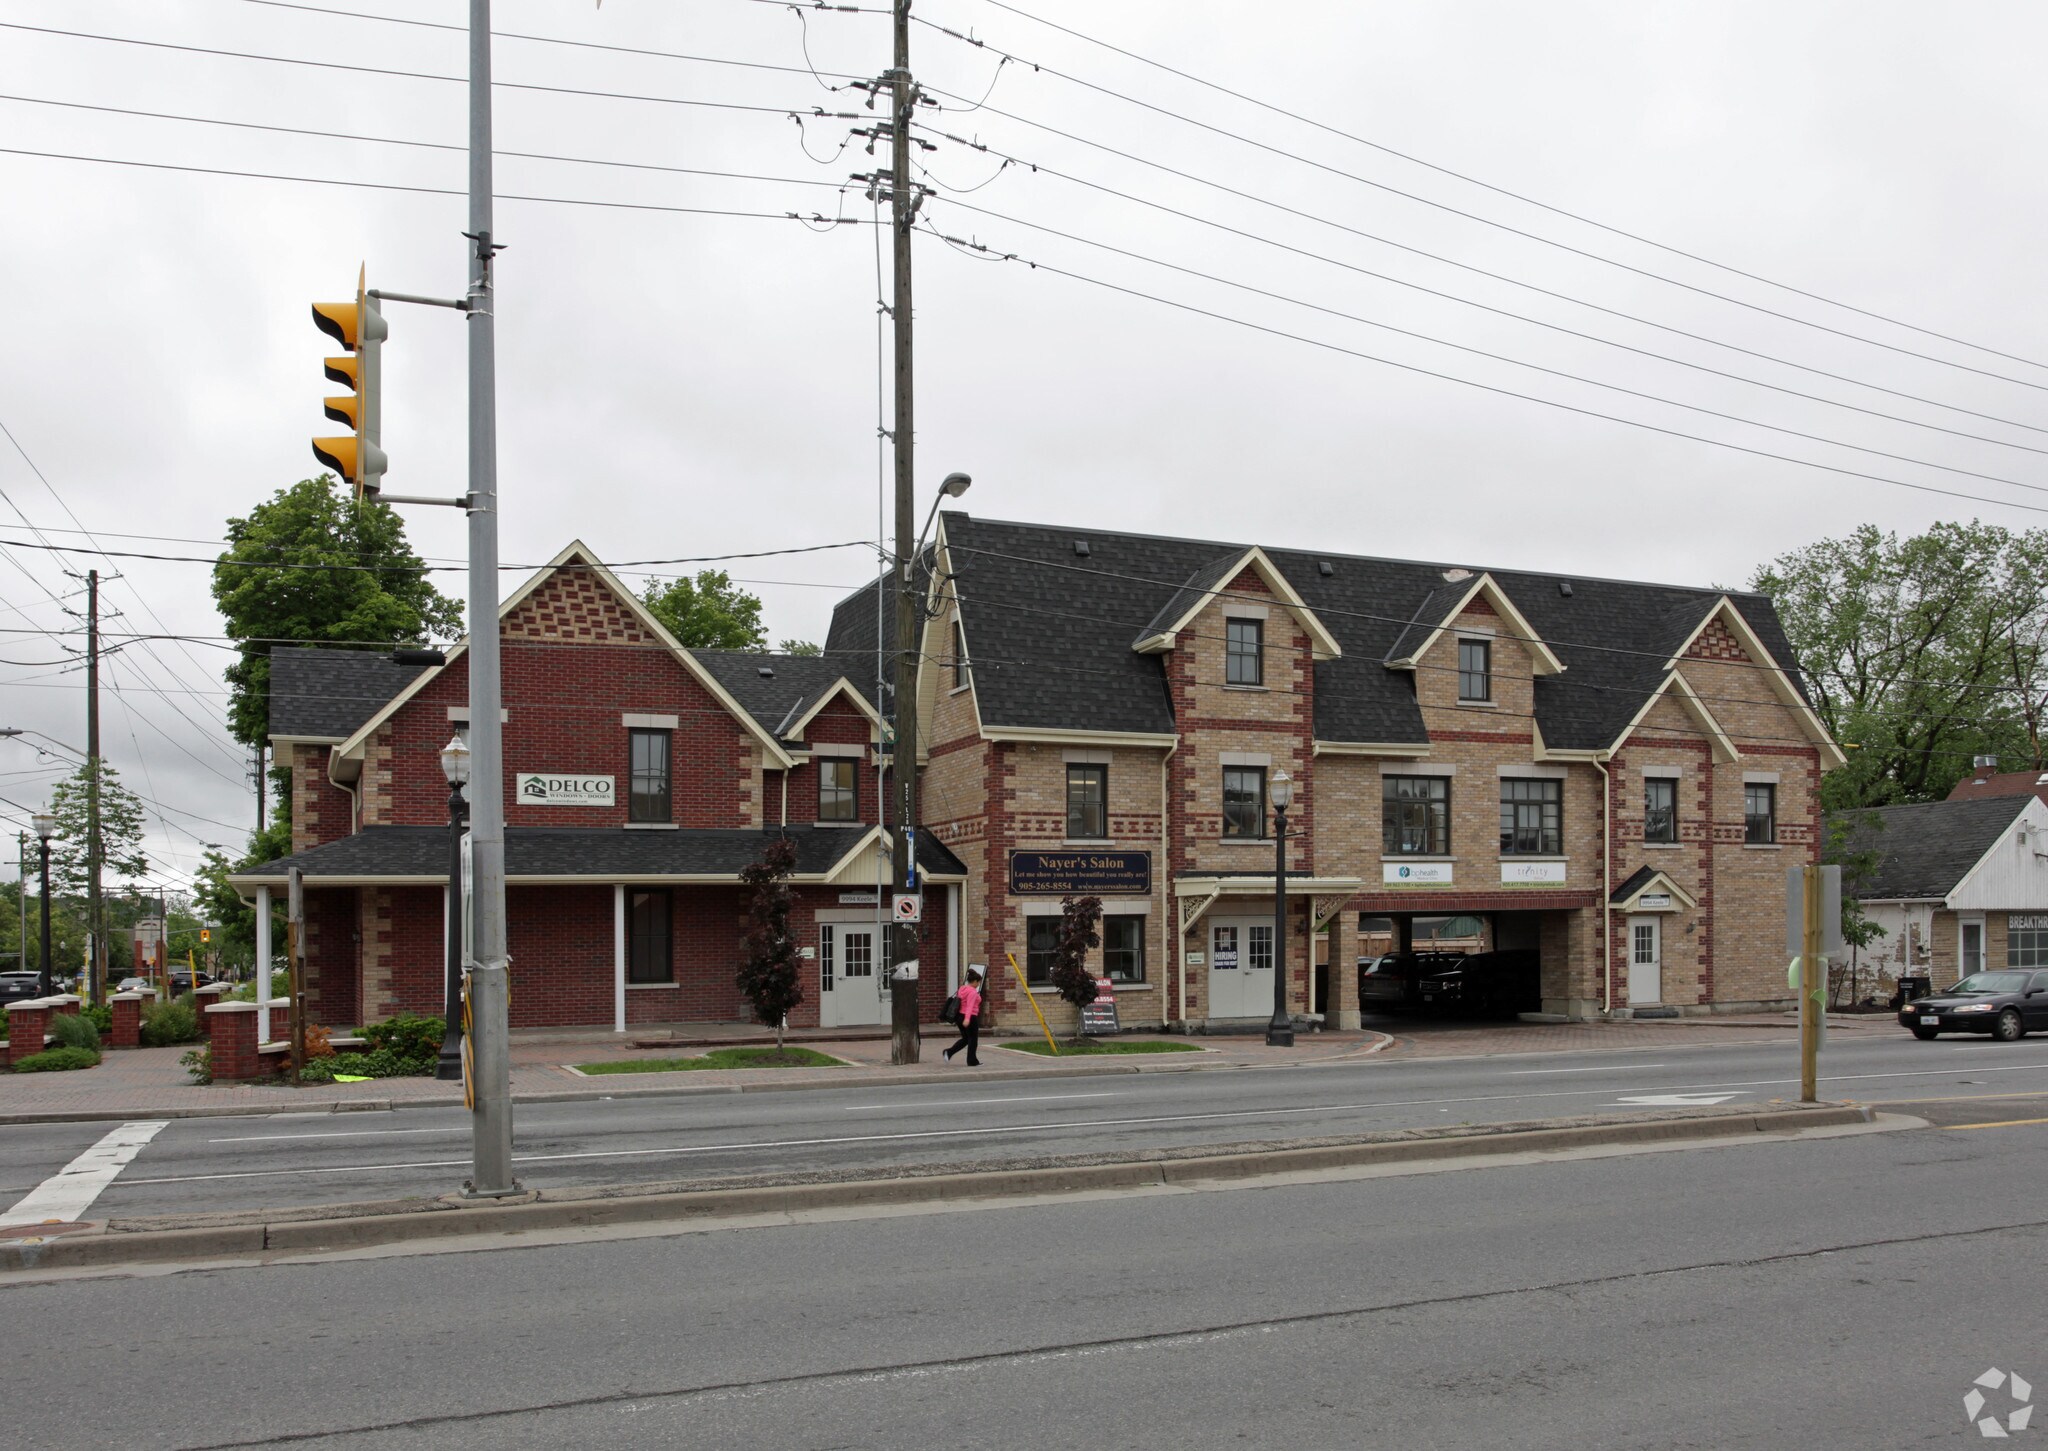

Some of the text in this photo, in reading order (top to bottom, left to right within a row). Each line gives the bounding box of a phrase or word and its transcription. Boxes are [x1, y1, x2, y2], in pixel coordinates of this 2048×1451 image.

[549, 779, 610, 793] DELCO
[1038, 856, 1124, 871] Nayer's Salon
[1118, 871, 1134, 879] really
[1410, 868, 1439, 877] bphealth
[1517, 865, 1548, 877] trinity
[1018, 882, 1072, 890] 905-265-8554
[1214, 951, 1237, 961] HIRING
